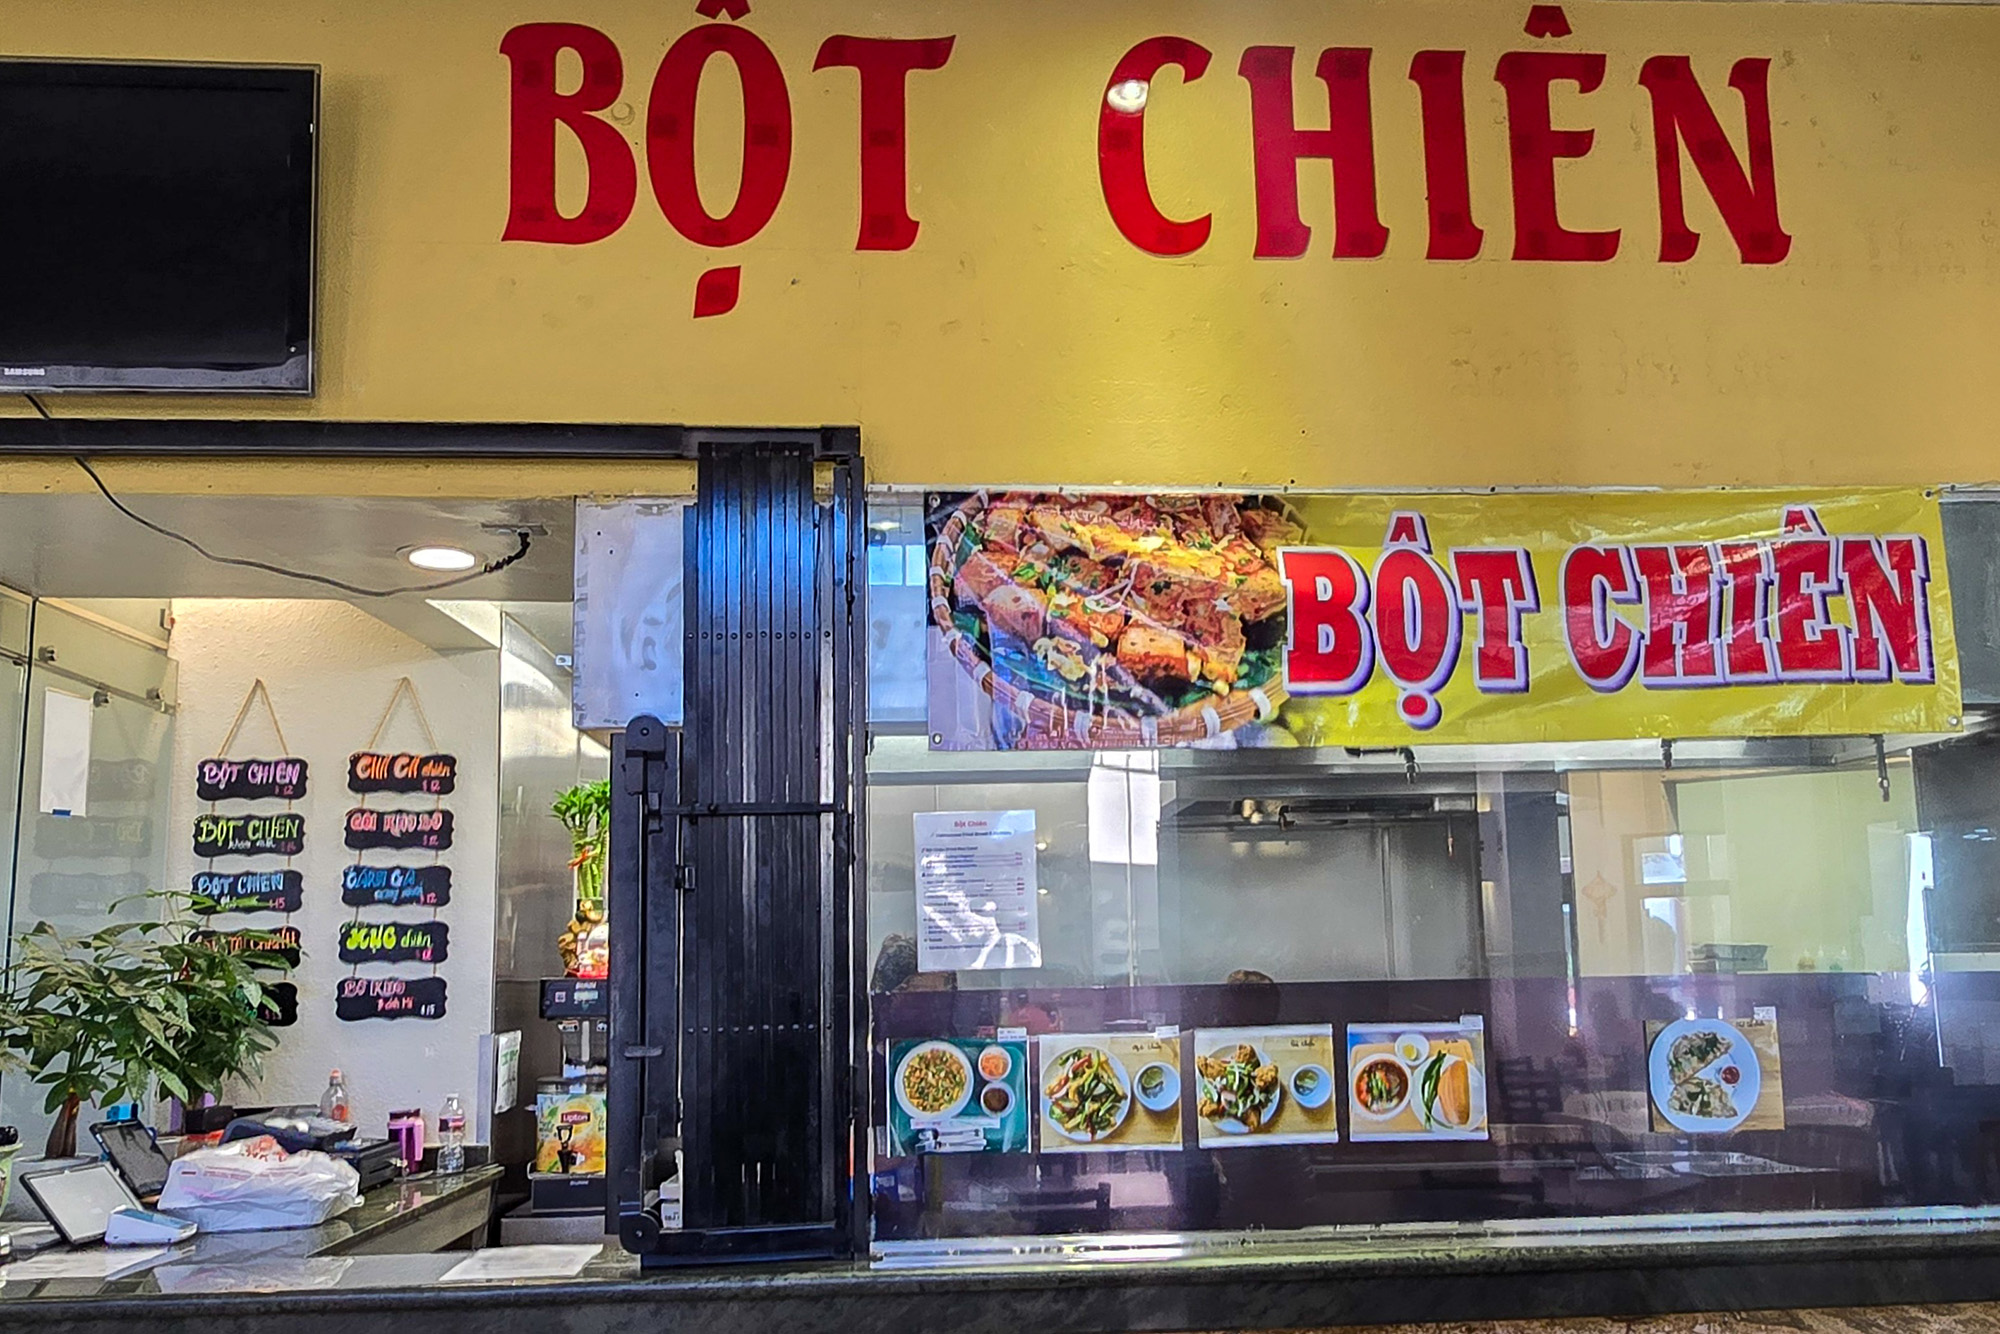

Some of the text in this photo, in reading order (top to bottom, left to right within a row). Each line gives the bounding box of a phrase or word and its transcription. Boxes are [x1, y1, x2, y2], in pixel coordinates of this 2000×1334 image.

[499, 0, 1792, 319] BỘT CHIÊN
[1276, 506, 1936, 730] BỘT CHIÊN
[563, 1114, 588, 1123] Lipton
